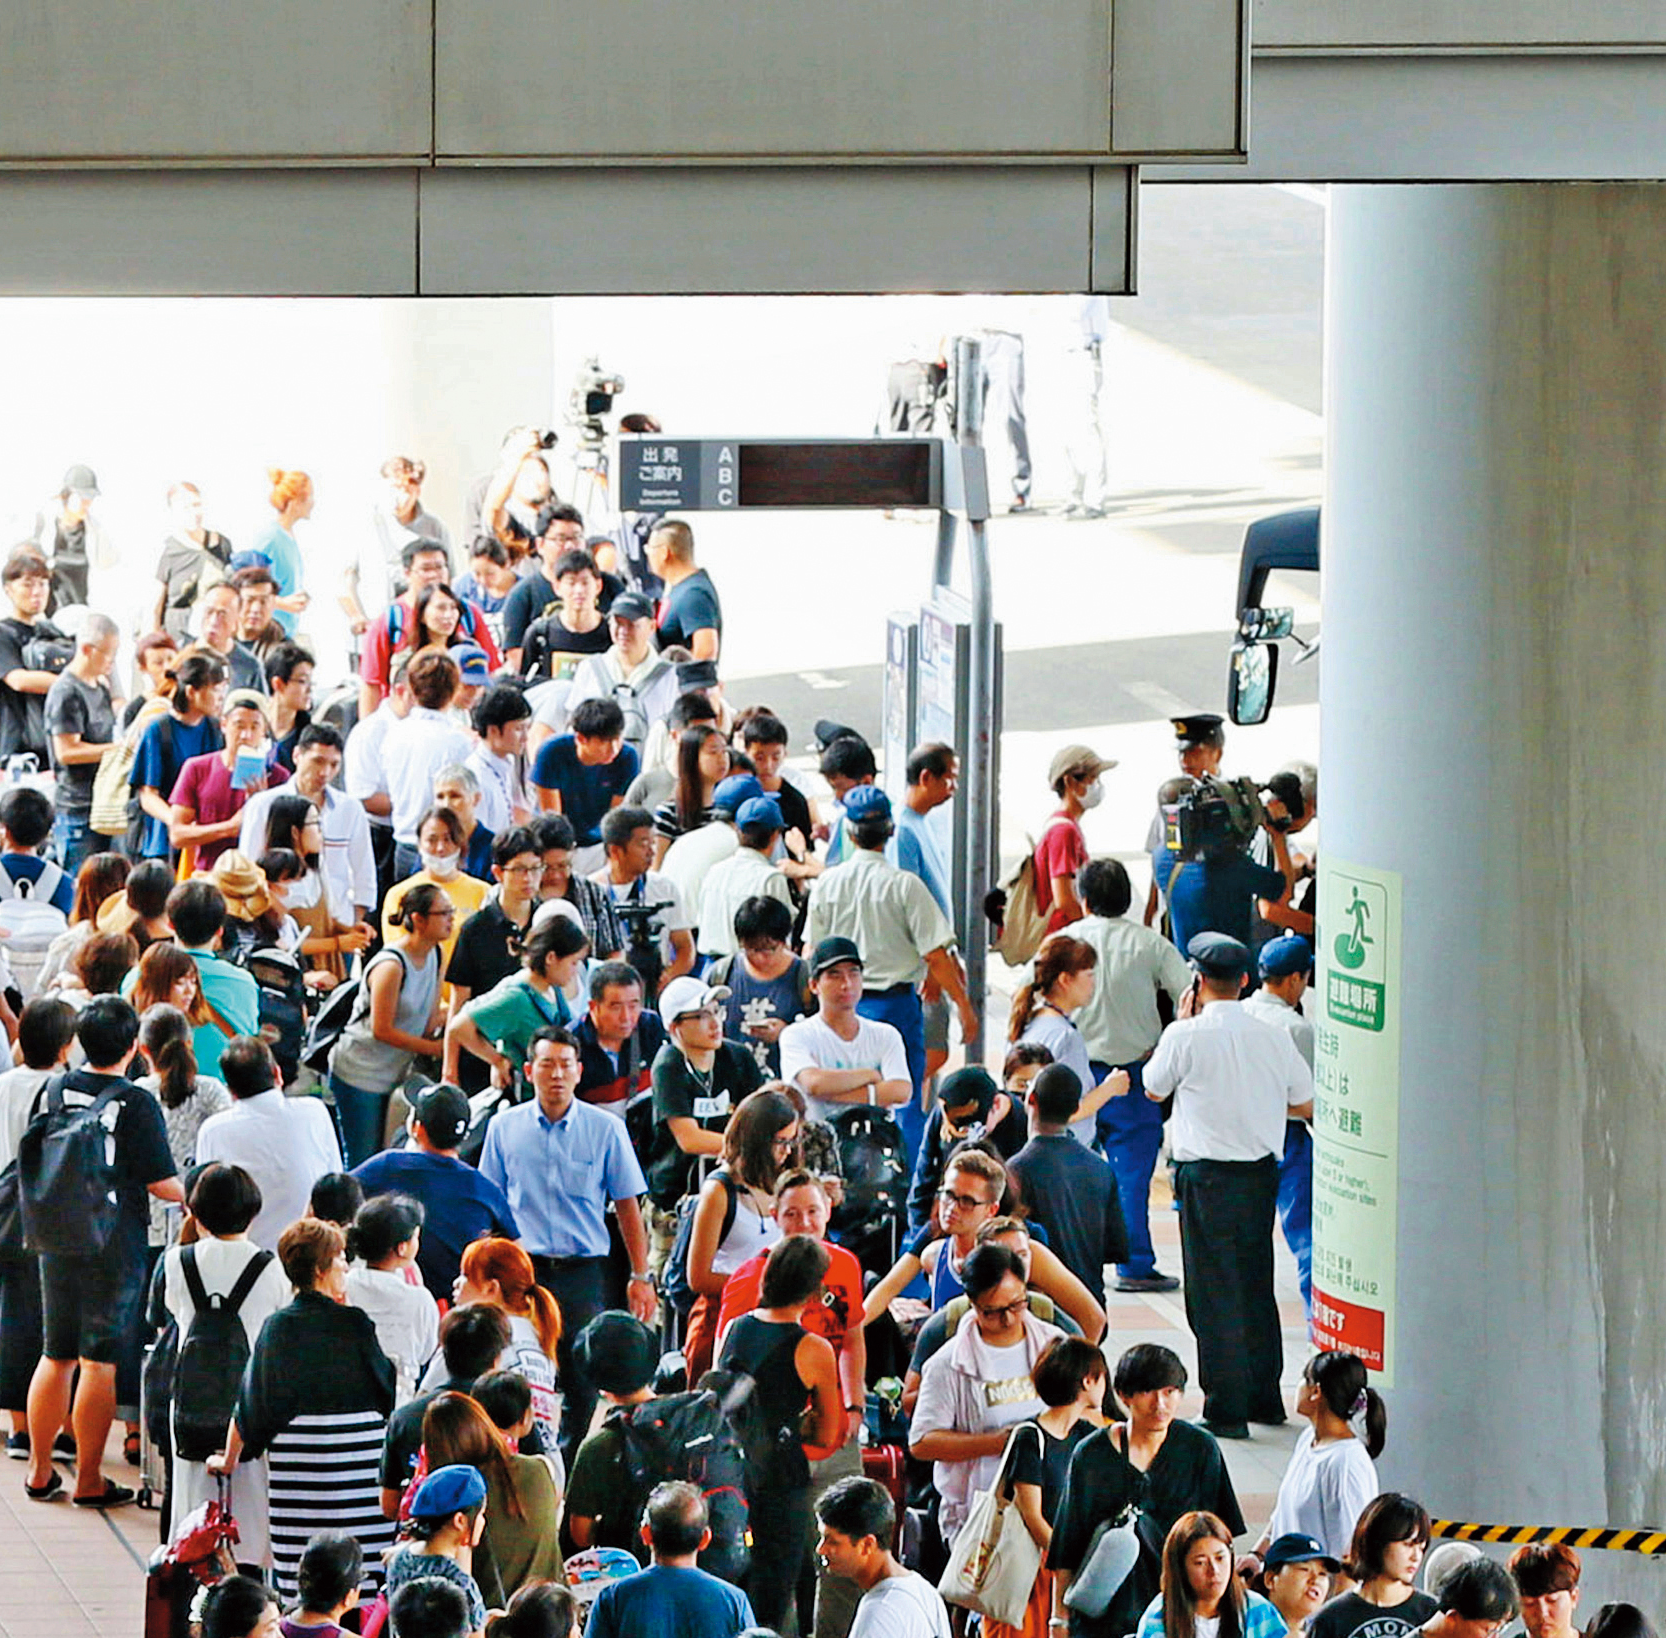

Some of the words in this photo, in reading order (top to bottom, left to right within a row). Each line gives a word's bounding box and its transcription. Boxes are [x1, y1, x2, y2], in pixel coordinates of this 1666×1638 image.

[719, 447, 733, 462] A
[719, 468, 732, 484] B
[718, 489, 733, 505] C
